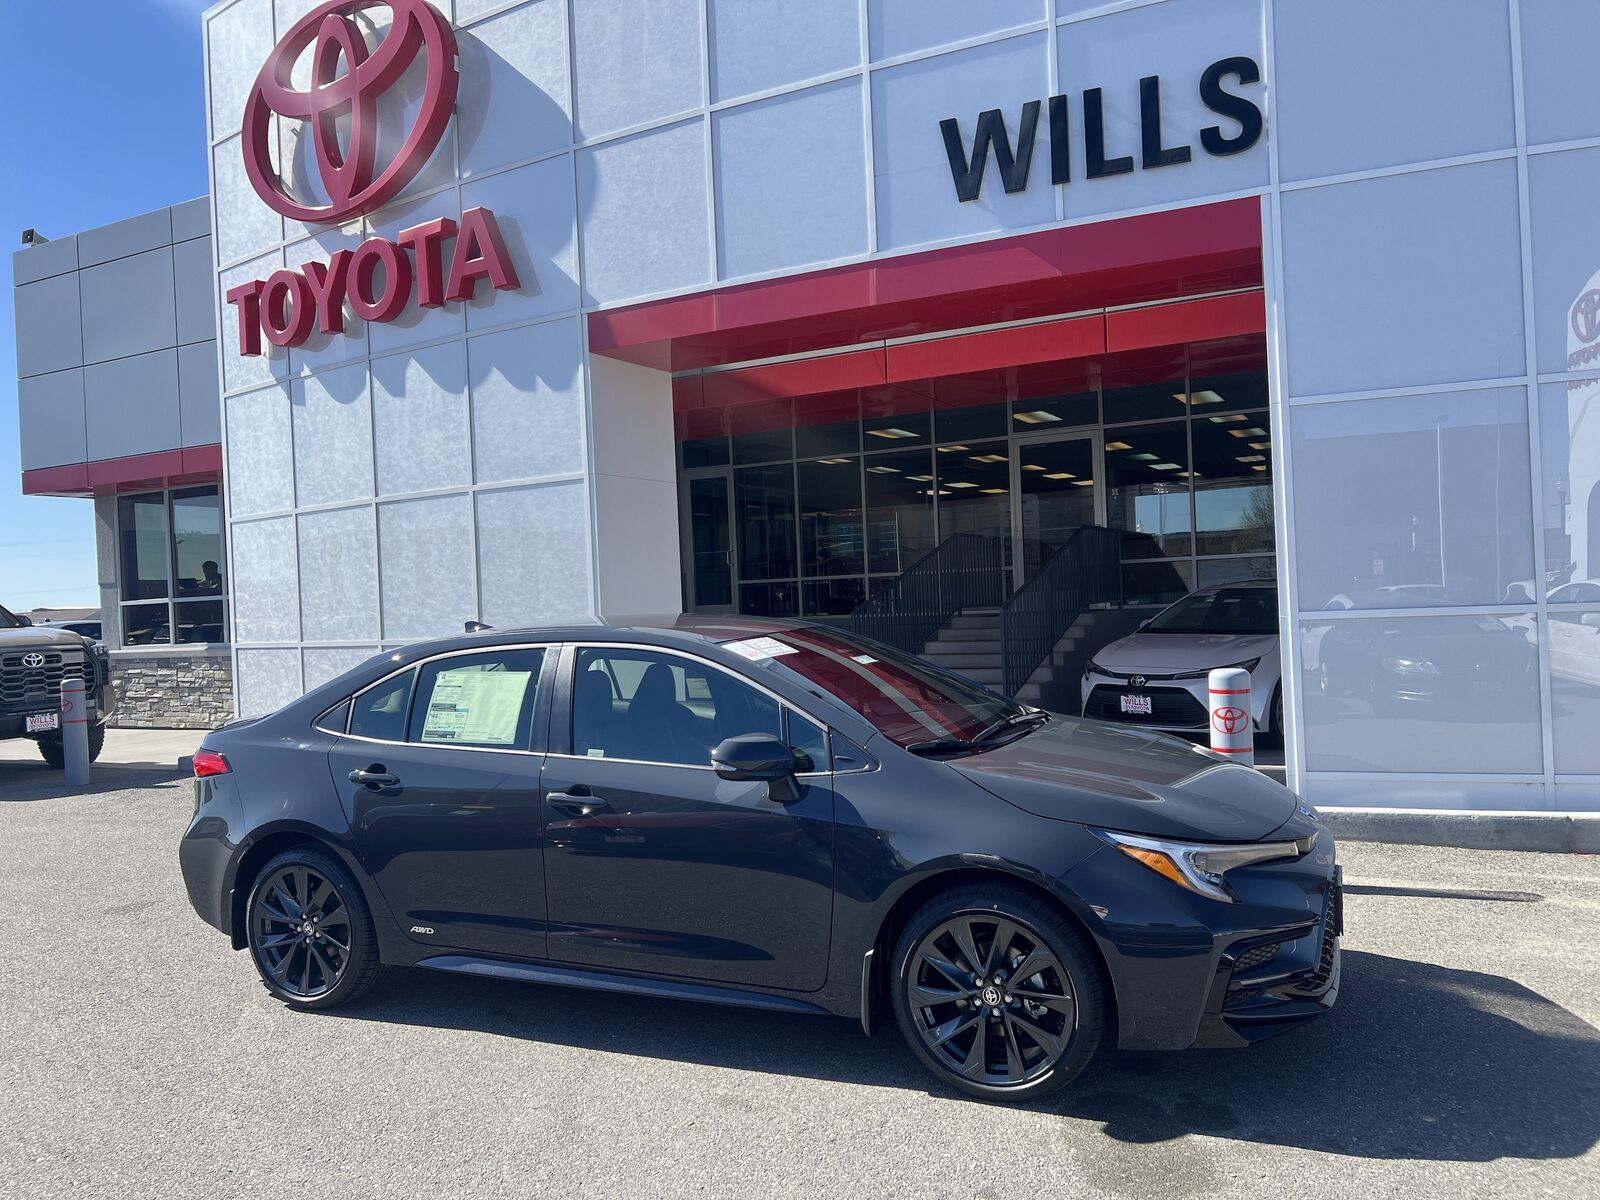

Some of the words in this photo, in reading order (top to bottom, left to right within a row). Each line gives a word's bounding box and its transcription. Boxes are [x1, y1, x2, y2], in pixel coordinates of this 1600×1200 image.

[939, 56, 1263, 203] WILLS
[226, 206, 521, 357] TOYOTA
[1124, 698, 1148, 707] WILLS
[29, 715, 55, 724] WILLS
[410, 926, 434, 934] AWD
